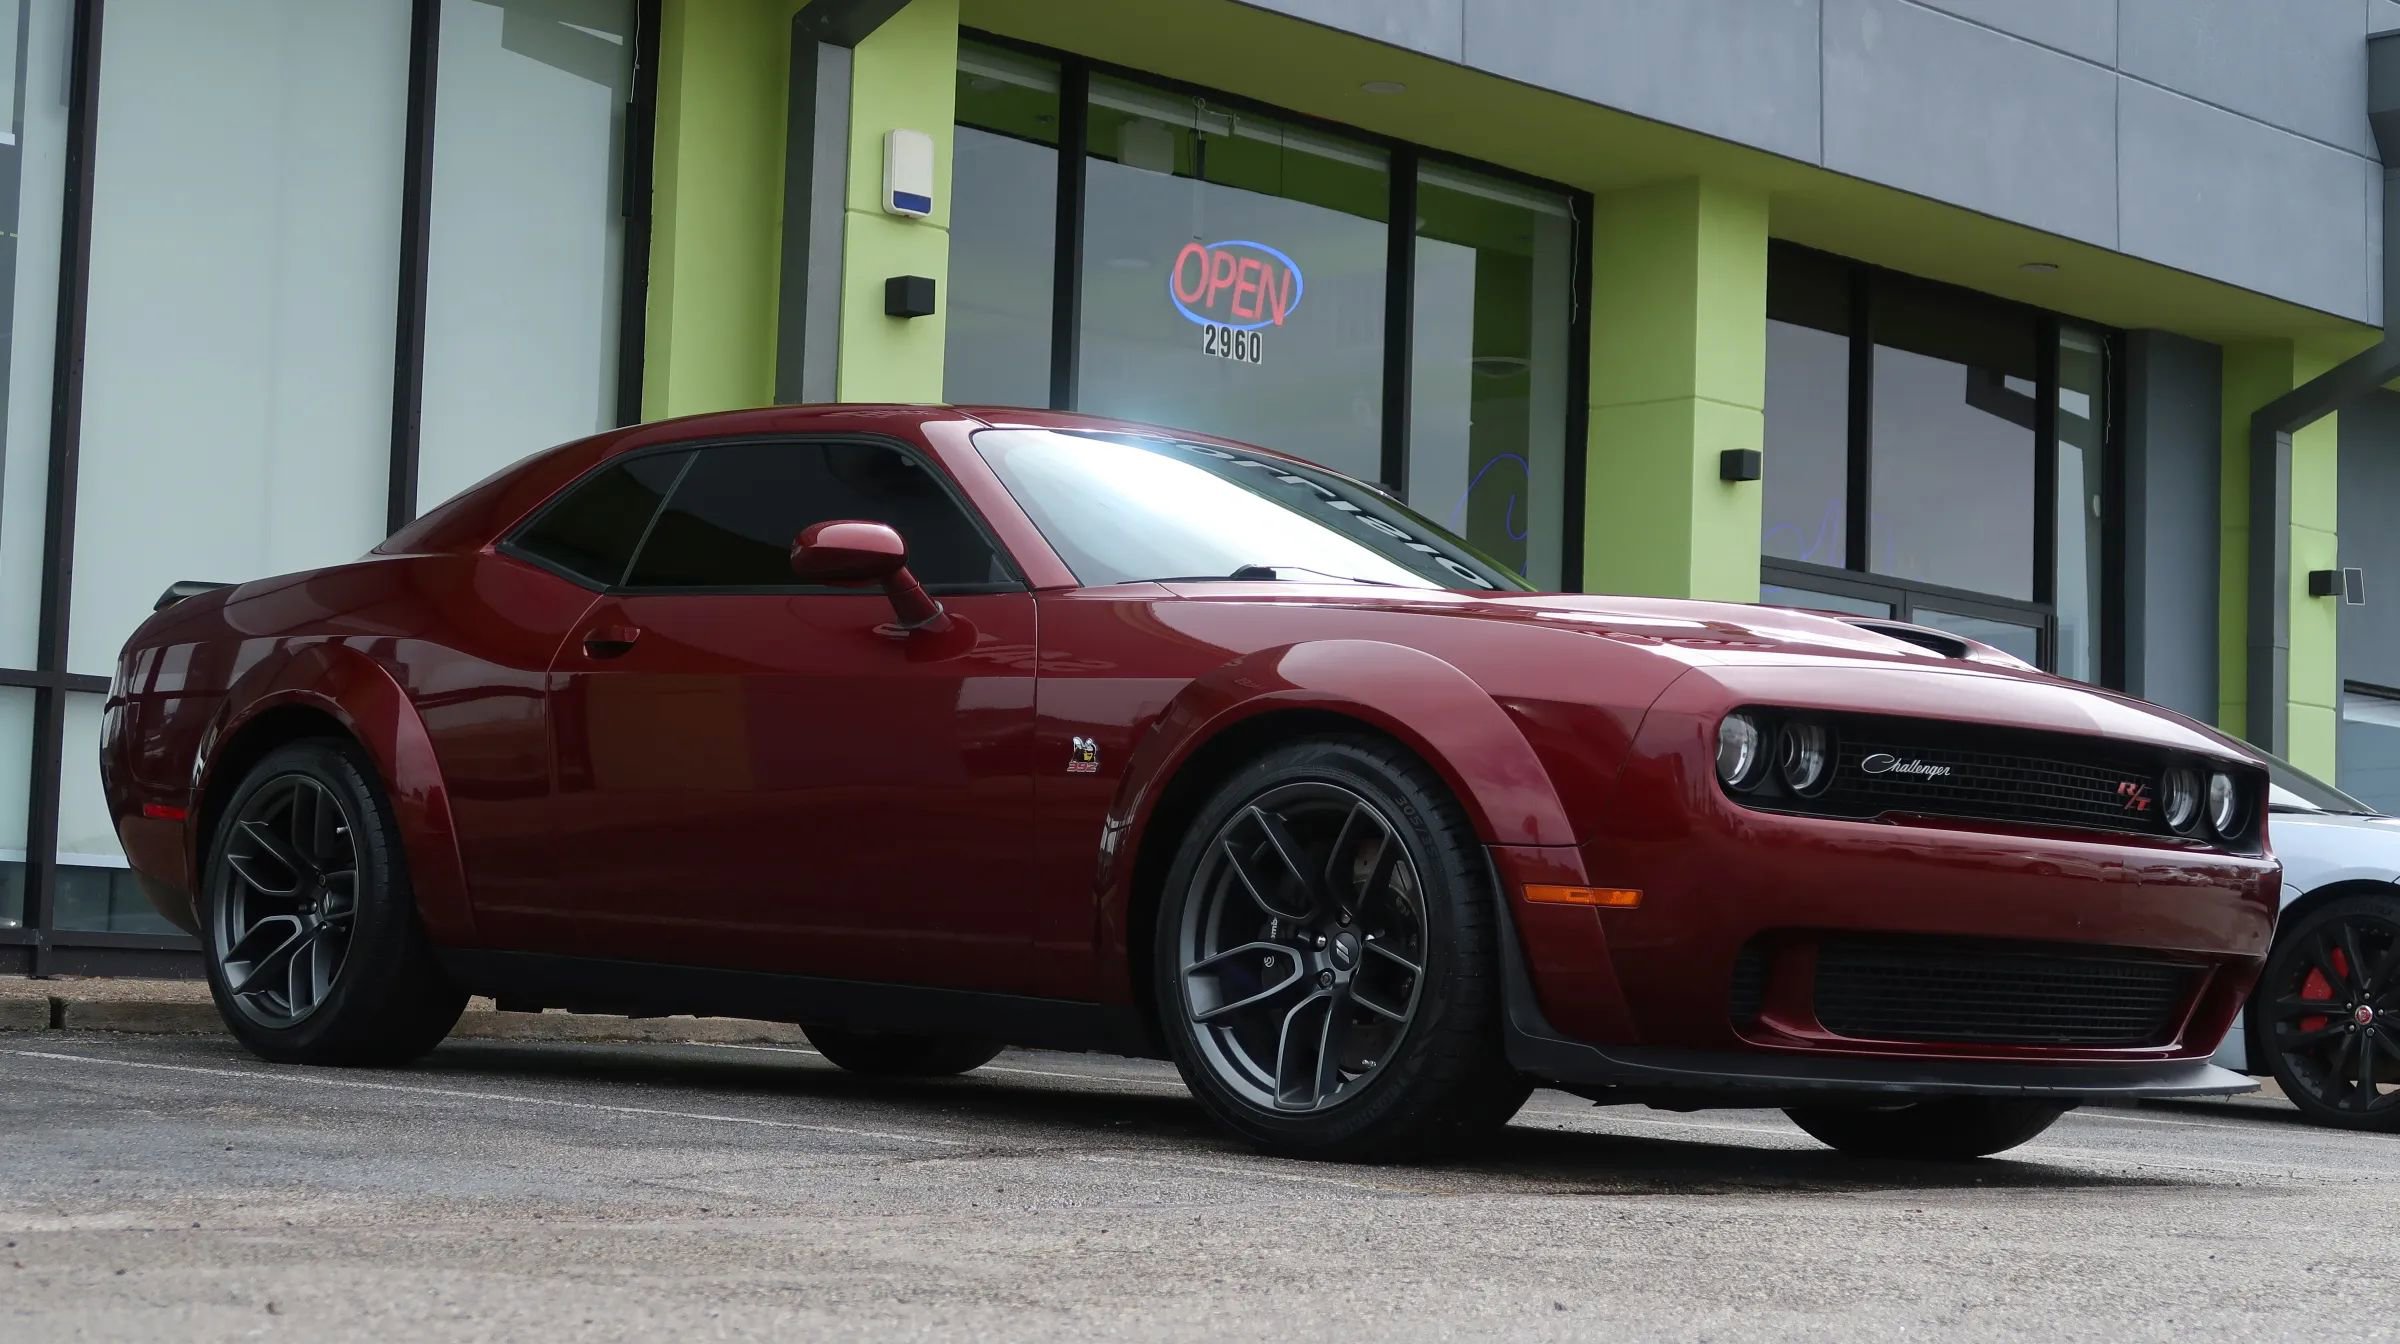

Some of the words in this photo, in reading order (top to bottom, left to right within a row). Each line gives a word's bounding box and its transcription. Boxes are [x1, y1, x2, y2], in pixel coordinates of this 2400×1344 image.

[1173, 242, 1292, 327] OPEN
[1204, 324, 1261, 364] 2960
[1861, 753, 1952, 781] Challenger
[2117, 782, 2151, 811] R/T
